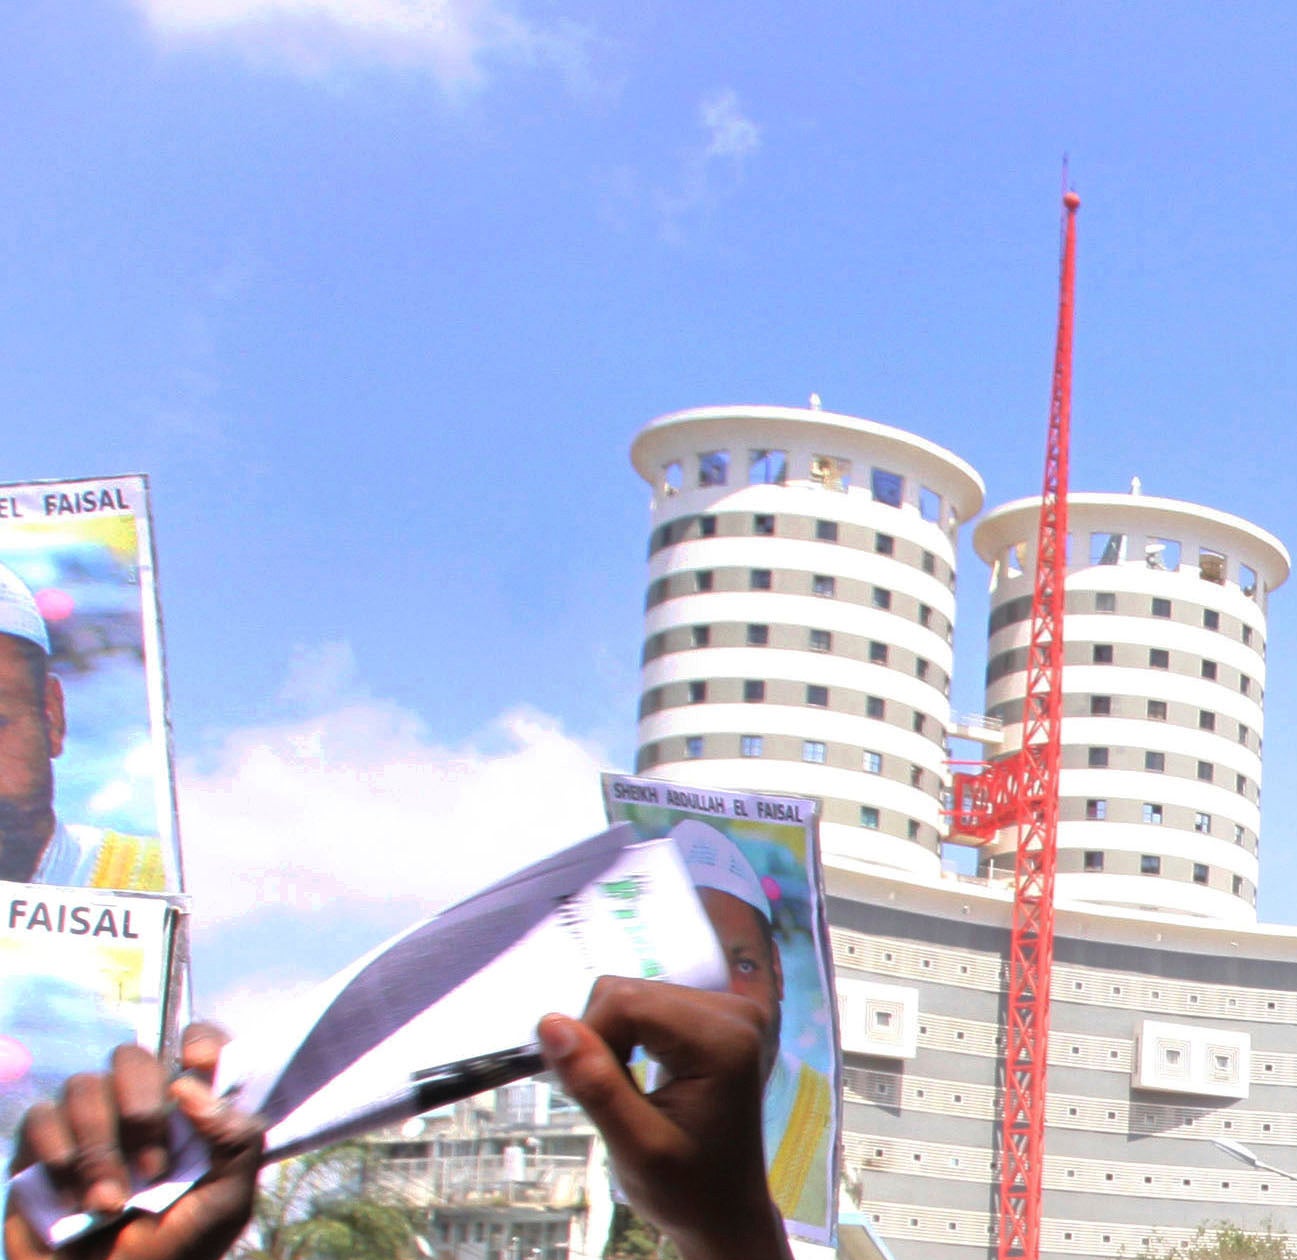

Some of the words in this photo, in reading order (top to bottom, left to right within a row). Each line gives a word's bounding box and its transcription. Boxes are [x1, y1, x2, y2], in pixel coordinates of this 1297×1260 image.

[43, 487, 130, 516] FAISAL
[614, 783, 658, 803] SHEIKH
[667, 789, 725, 813] ABDULLAH
[734, 799, 748, 816] EL
[757, 801, 803, 823] FAISAL
[9, 899, 139, 939] FAISAL
